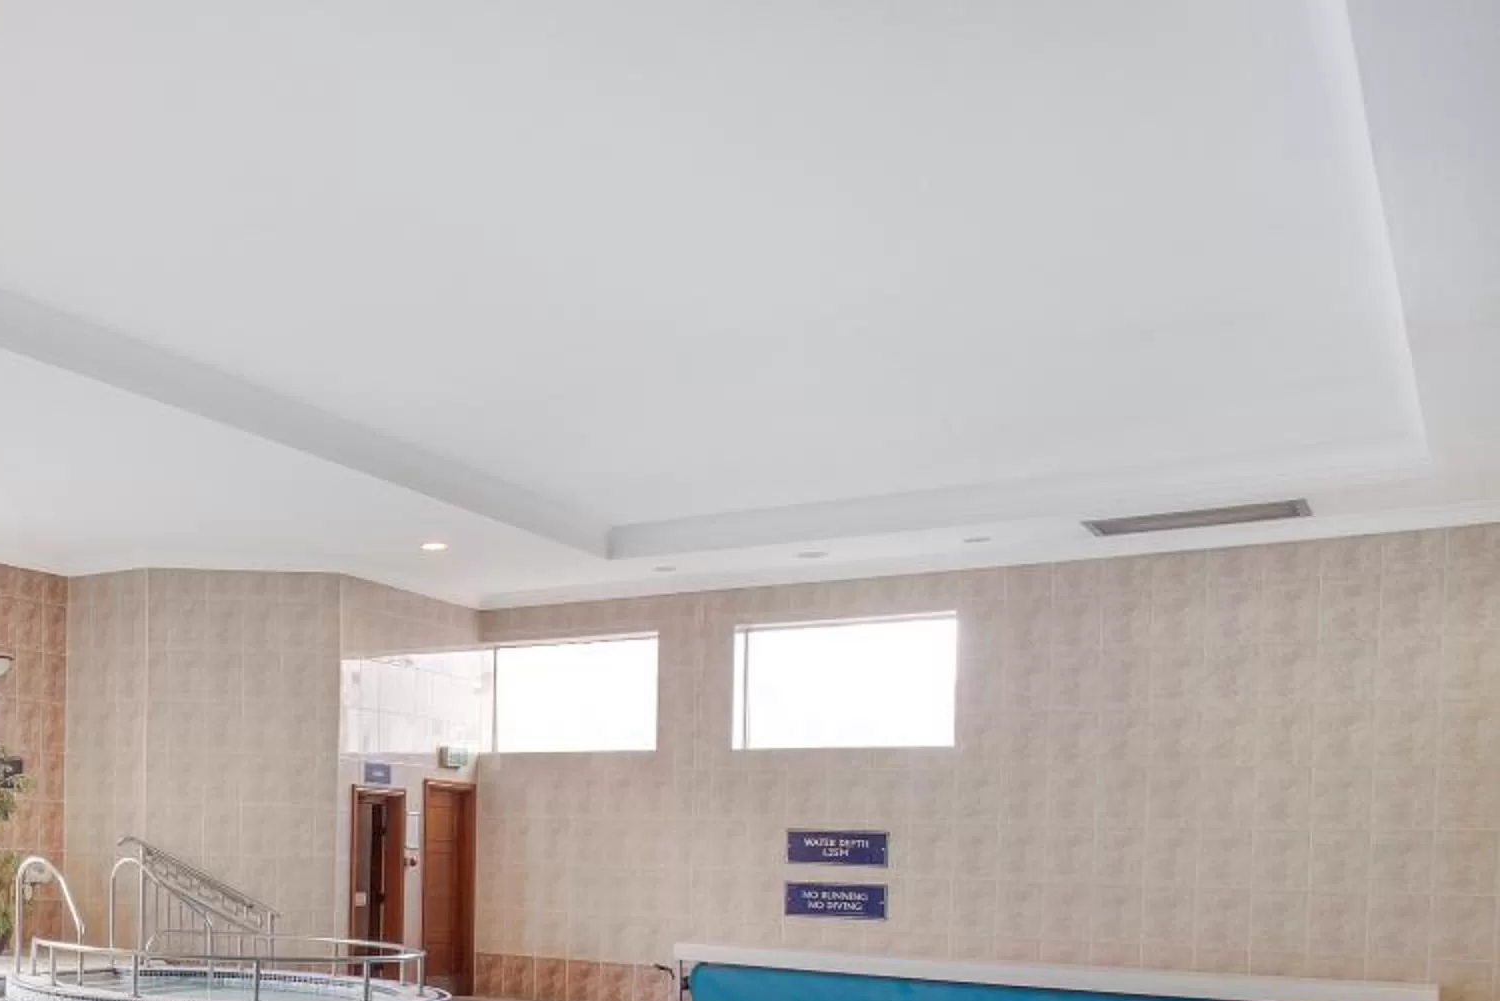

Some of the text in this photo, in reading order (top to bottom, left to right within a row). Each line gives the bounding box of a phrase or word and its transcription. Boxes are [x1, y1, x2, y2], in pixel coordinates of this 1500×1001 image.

[803, 837, 869, 849] WATER DEPTH
[802, 890, 869, 902] NO RUNNING
[808, 900, 863, 911] NO DIVING
